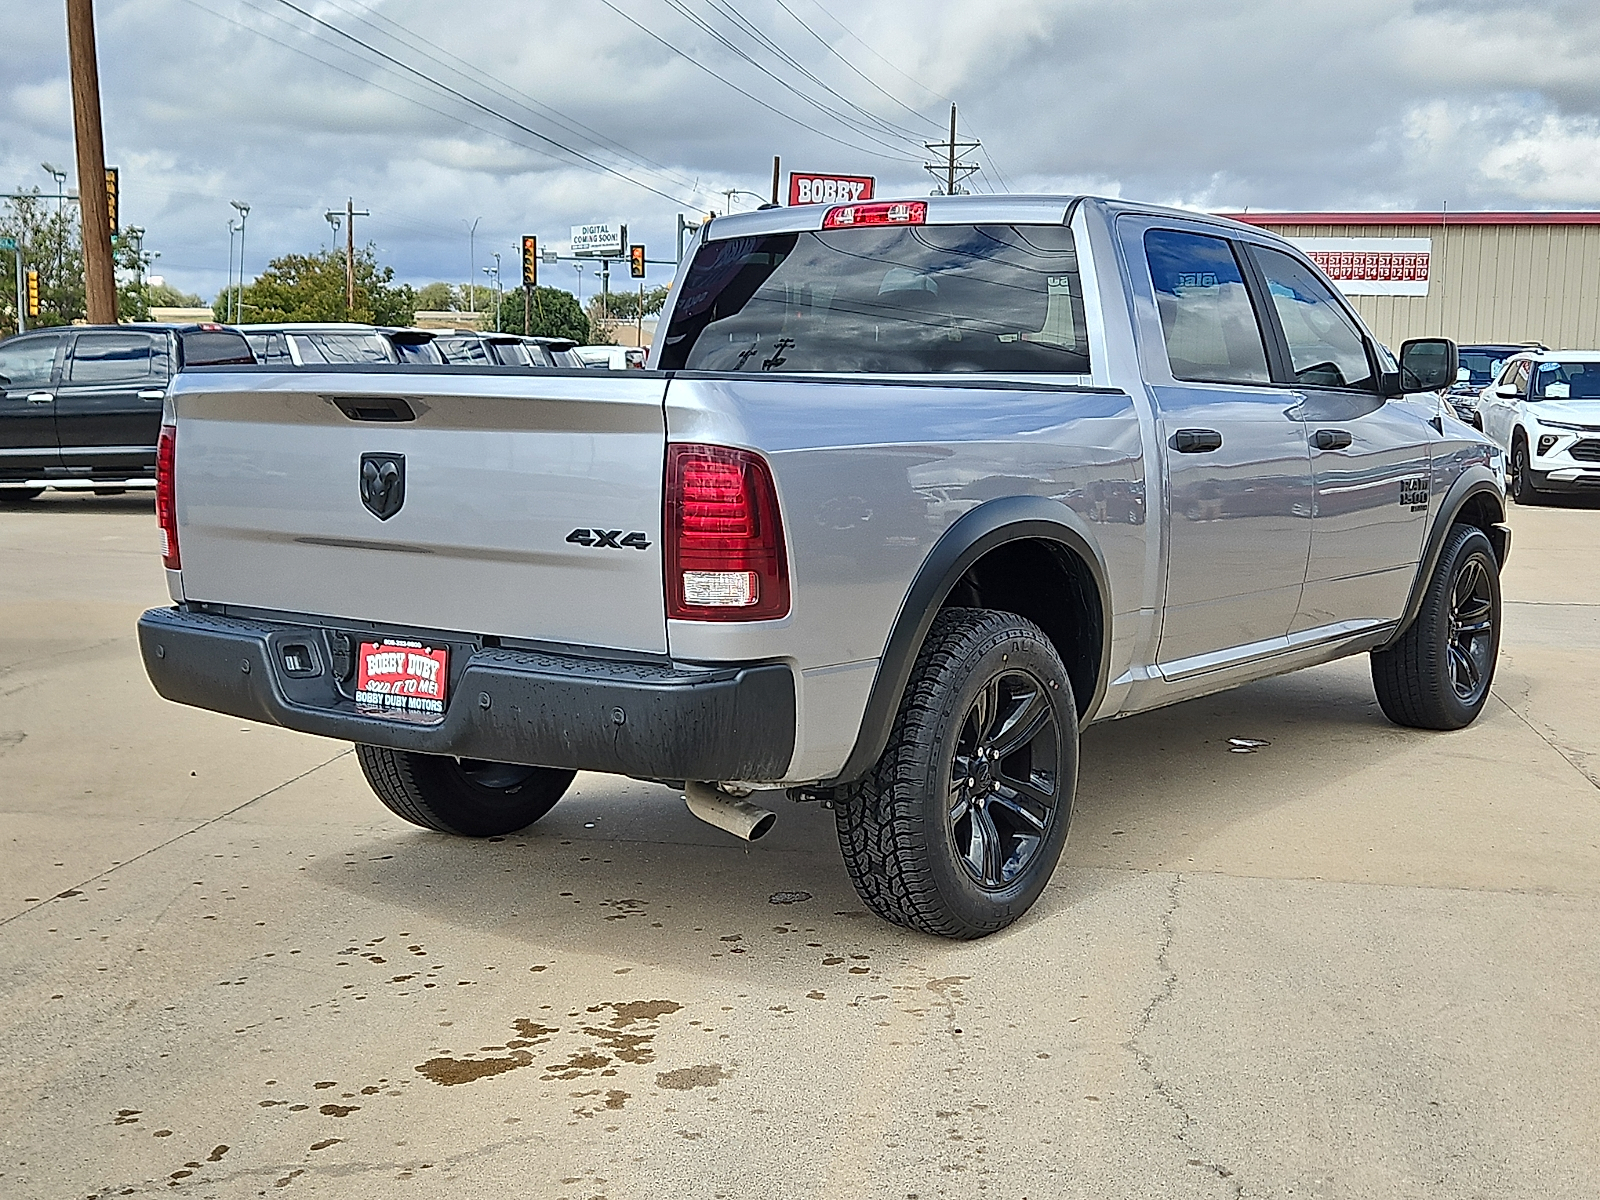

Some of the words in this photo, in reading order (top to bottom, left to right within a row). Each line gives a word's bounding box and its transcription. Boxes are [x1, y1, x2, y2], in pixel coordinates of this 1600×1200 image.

[798, 179, 865, 203] BOBBY
[574, 234, 597, 243] COMING
[599, 233, 618, 242] SOON!
[582, 225, 609, 234] DIGITAL
[1366, 268, 1377, 276] 14
[366, 652, 405, 676] BOBBY
[406, 653, 440, 681] DUBY
[366, 680, 391, 693] SOLD
[391, 681, 404, 694] IT
[404, 679, 417, 692] TO
[418, 680, 438, 696] ME!
[356, 691, 383, 704] BOBBY
[385, 694, 407, 707] DUBY
[408, 697, 443, 711] MOTORS
